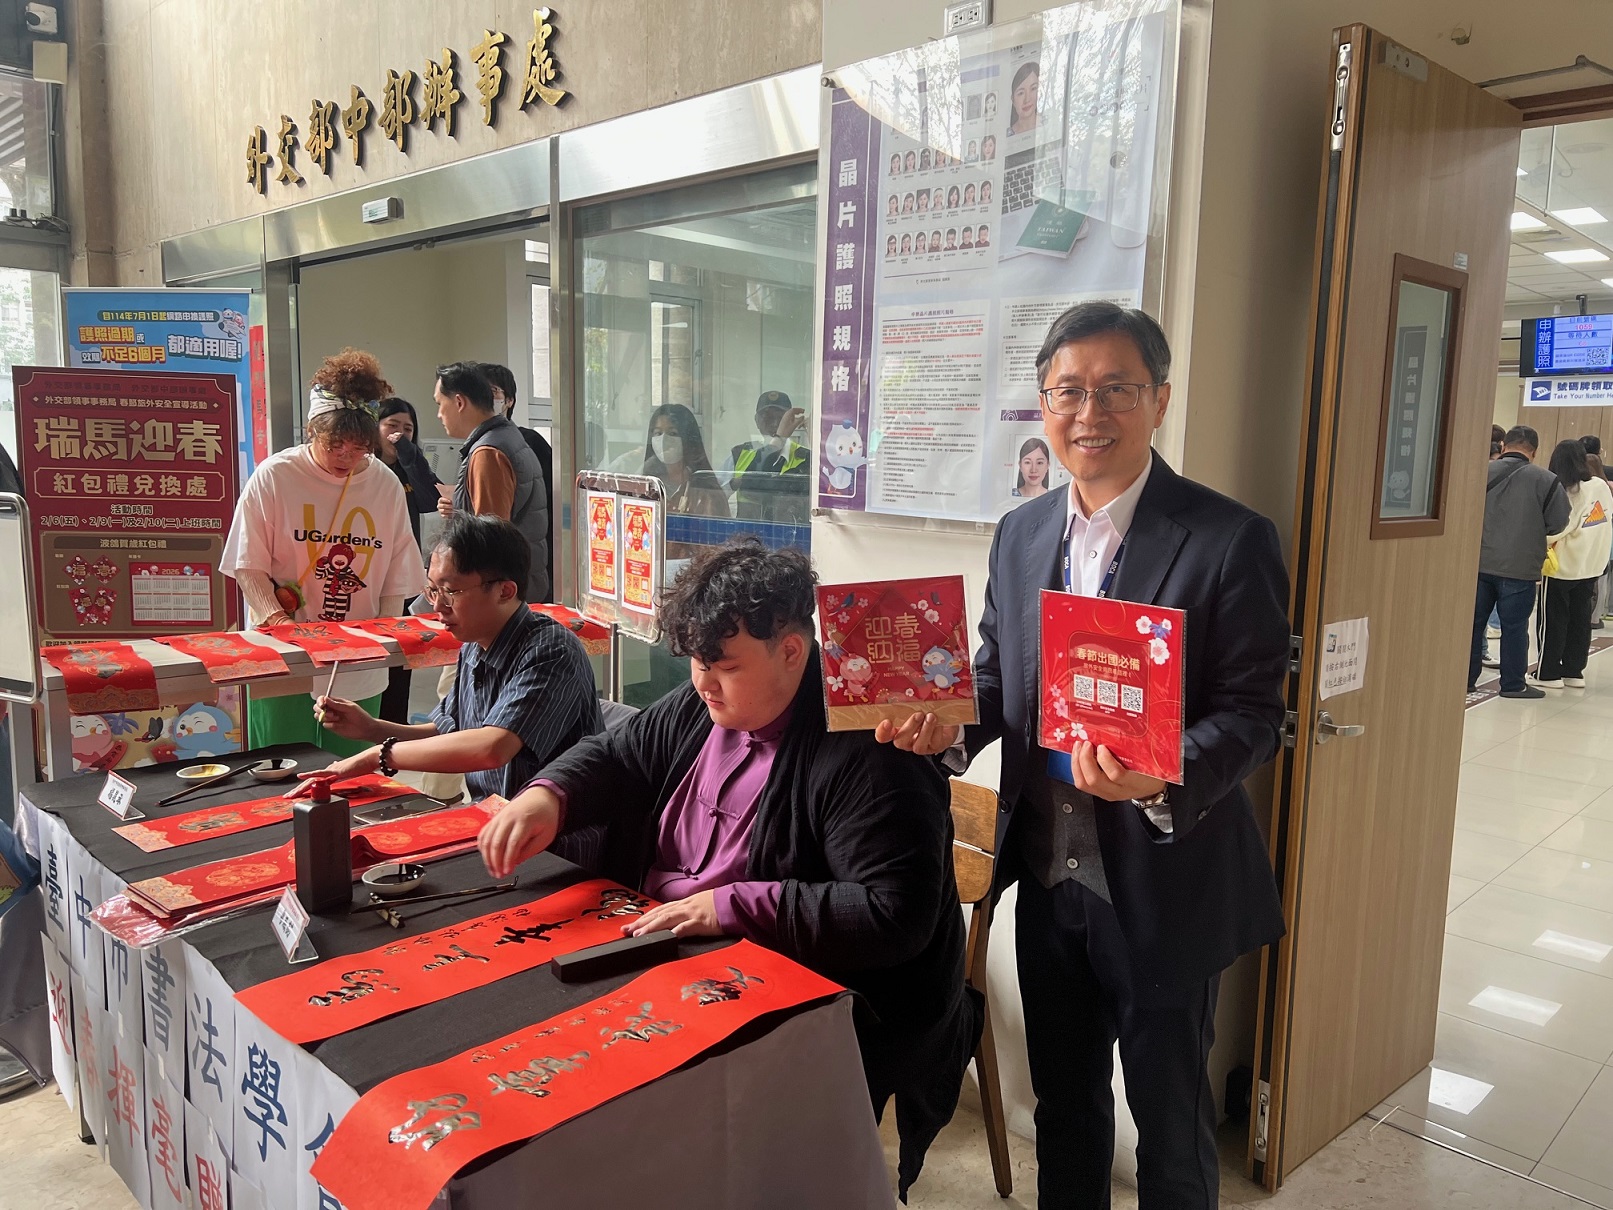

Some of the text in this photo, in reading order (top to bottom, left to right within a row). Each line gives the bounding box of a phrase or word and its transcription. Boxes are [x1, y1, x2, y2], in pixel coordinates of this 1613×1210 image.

[246, 6, 566, 195] 外交部中部辦事處
[831, 158, 858, 392] 晶片護照規格
[1538, 319, 1552, 367] 申辦護照
[45, 396, 117, 407] 外交部領事事務局
[34, 416, 223, 464] 瑞馬迎春
[53, 472, 208, 497] 紅包禮兌換處
[111, 504, 153, 515] 活動時間
[294, 529, 383, 549] UGarden's
[1077, 647, 1140, 671] 春節出國必備
